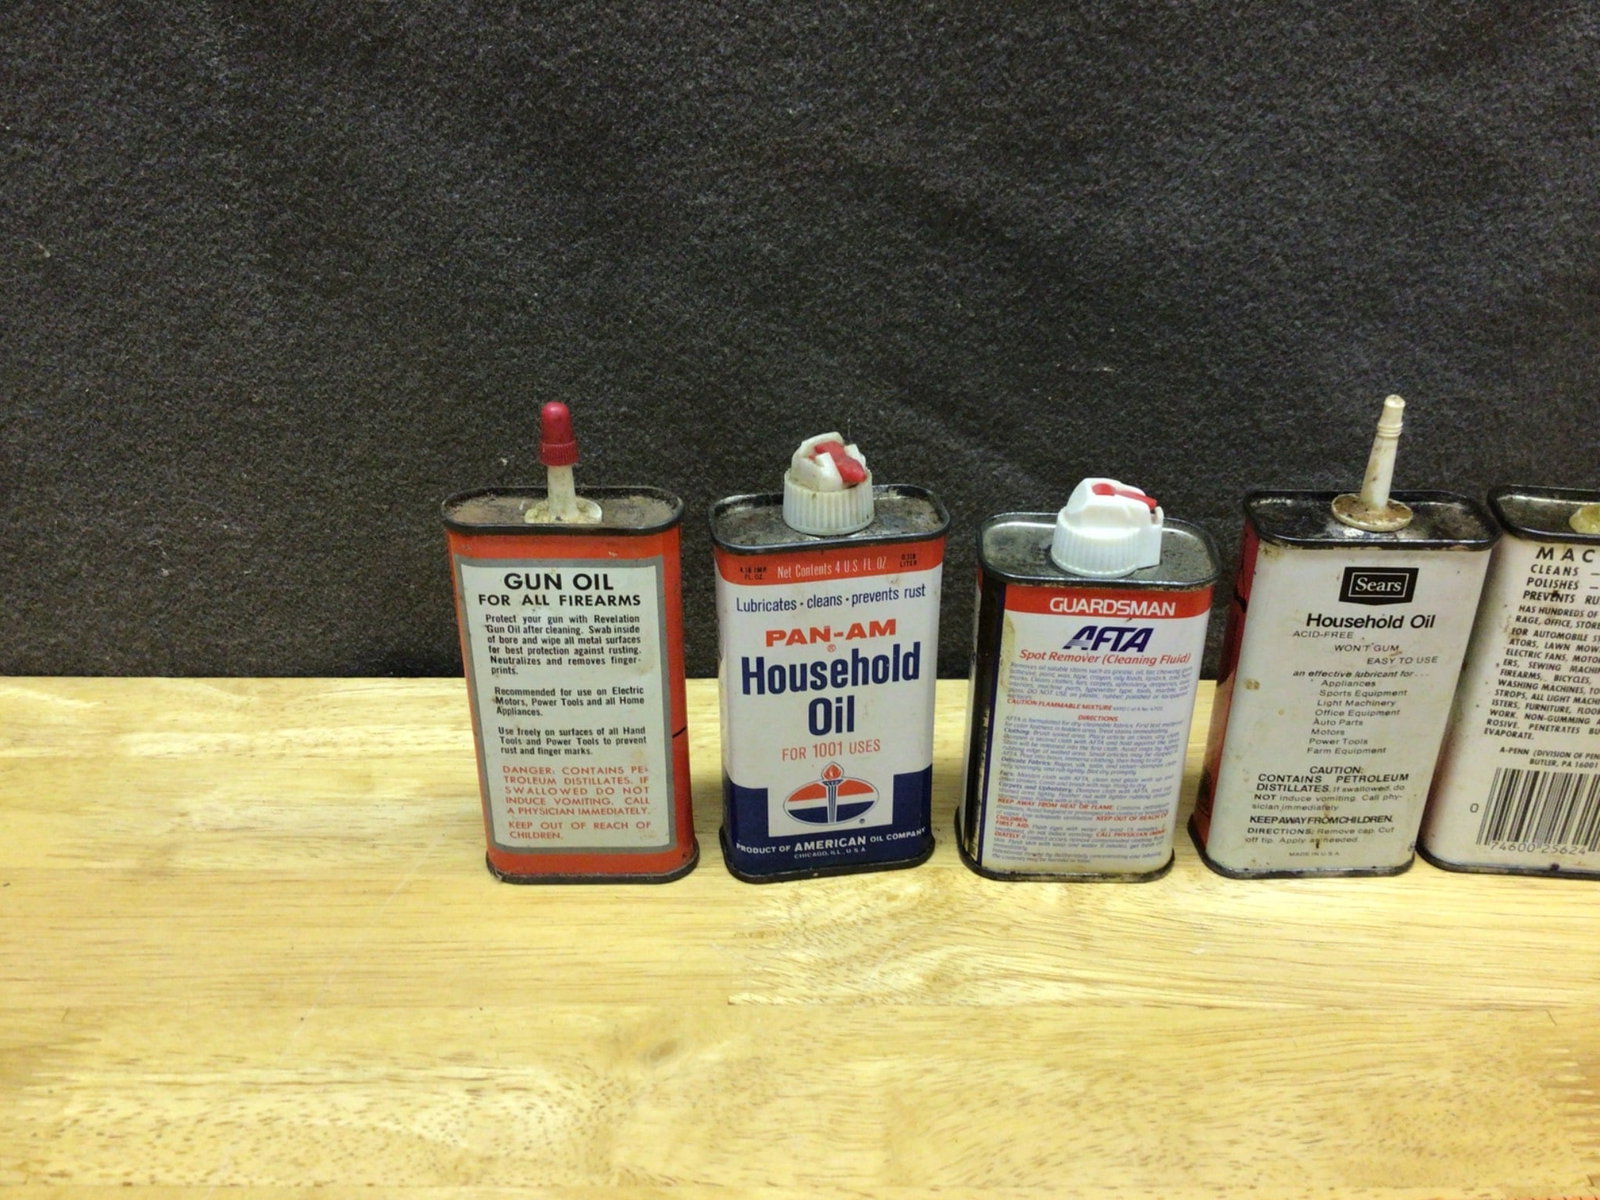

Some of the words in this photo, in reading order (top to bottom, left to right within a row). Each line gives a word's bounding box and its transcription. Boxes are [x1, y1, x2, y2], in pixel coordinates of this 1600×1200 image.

[777, 567, 792, 579] Net
[795, 563, 832, 577] Contents
[835, 560, 840, 572] 4
[1530, 564, 1580, 577] CLEANS
[504, 573, 562, 590] GUN
[573, 573, 614, 590] OIL
[1355, 577, 1402, 592] Sears
[1526, 577, 1580, 590] POLISHES
[479, 595, 510, 606] FOR
[522, 595, 549, 606] ALL
[559, 595, 641, 606] FIREARMS
[737, 597, 797, 613] Lubricates
[807, 594, 843, 609] cleans
[851, 586, 899, 607] prevents
[904, 583, 926, 599] rust
[1523, 590, 1576, 604] PREVENTS
[1049, 597, 1176, 616] GUARDSMAN
[1518, 605, 1536, 613] HAS
[1538, 606, 1584, 618] HUNDREDS
[1587, 609, 1598, 618] OF
[486, 614, 517, 623] Protect
[522, 616, 541, 625] your
[547, 616, 564, 625] gun
[569, 614, 588, 623] with
[594, 614, 640, 623] Revelation
[1306, 613, 1404, 629] Household
[1410, 614, 1436, 629] Oil
[1515, 615, 1541, 626] RAGE,
[1544, 618, 1573, 629] OFFICE,
[487, 625, 505, 634] Gun
[508, 625, 521, 634] Oil
[523, 625, 542, 634] after
[589, 625, 611, 634] Swab
[614, 625, 640, 634] inside
[766, 618, 896, 647] PAN-AM
[1062, 625, 1154, 653] AFTA
[1293, 631, 1354, 639] ACID-FREE
[489, 646, 500, 654] for
[505, 646, 523, 654] best
[527, 646, 569, 656] protection
[574, 646, 604, 656] against
[608, 646, 641, 656] rusting.
[1506, 648, 1543, 659] ELECTRIC
[490, 656, 541, 665] Neutralizes
[546, 656, 562, 665] and
[611, 656, 641, 666] finger-
[1019, 649, 1047, 661] Spot
[1049, 652, 1099, 664] Remover
[1101, 653, 1157, 667] (Cleaning
[1160, 652, 1191, 665] Fluid)
[1367, 657, 1396, 665] EASY
[491, 666, 519, 676] prints.
[741, 641, 921, 695] Household
[1308, 670, 1352, 678] effective
[1321, 679, 1376, 687] Appliances
[1498, 679, 1539, 690] WASHING
[494, 687, 555, 696] Recommended
[560, 687, 572, 696] for
[612, 687, 644, 696] Electric
[1319, 689, 1352, 698] Sports
[1355, 689, 1408, 698] Equipment
[495, 697, 528, 706] Motors,
[531, 697, 557, 706] Power
[561, 697, 584, 706] Tools
[587, 697, 602, 706] and
[605, 697, 616, 706] all
[620, 697, 645, 706] Home
[1007, 698, 1037, 707] CAUTION
[1038, 701, 1080, 710] FLAMMABLE
[1317, 699, 1342, 707] Light
[1345, 699, 1396, 707] Machinery
[496, 707, 543, 717] Appliances.
[808, 695, 855, 736] Oil
[1348, 709, 1400, 717] Equipment
[1311, 728, 1345, 736] Motors
[499, 737, 522, 745] Tools
[526, 737, 541, 745] and
[546, 736, 571, 745] Power
[577, 736, 599, 745] Tools
[603, 736, 612, 745] to
[616, 736, 647, 746] prevent
[501, 746, 517, 755] rust
[520, 746, 535, 755] and
[537, 746, 561, 756] finger
[564, 746, 593, 755] marks.
[782, 747, 806, 761] FOR
[812, 741, 843, 758] 1001
[849, 738, 881, 755] USES
[1334, 747, 1387, 755] Equipment
[1500, 746, 1530, 755] A-PENN
[562, 766, 624, 774] CONTAINS
[1258, 774, 1322, 783] CONTAINS
[1336, 773, 1409, 783] PETROLEUM
[505, 787, 588, 795] SWALLOWED
[596, 787, 615, 795] DO
[623, 787, 649, 795] NOT
[506, 797, 546, 805] INDUCE
[553, 797, 614, 805] VOMITING.
[624, 797, 649, 805] CALL
[507, 807, 515, 815] A
[518, 807, 575, 815] PHYSICIAN
[1250, 815, 1278, 824] KEEP
[508, 821, 533, 830] KEEP
[540, 821, 563, 830] OUT
[571, 821, 586, 830] OF
[594, 821, 628, 830] REACH
[636, 821, 652, 830] OF
[736, 843, 776, 854] PRODUCT
[779, 845, 791, 853] OF
[794, 835, 867, 852] AMERICAN
[870, 834, 884, 843] OIL
[886, 827, 926, 841] COMPANY
[1490, 842, 1536, 853] 74600
[1541, 844, 1587, 855] 25624
